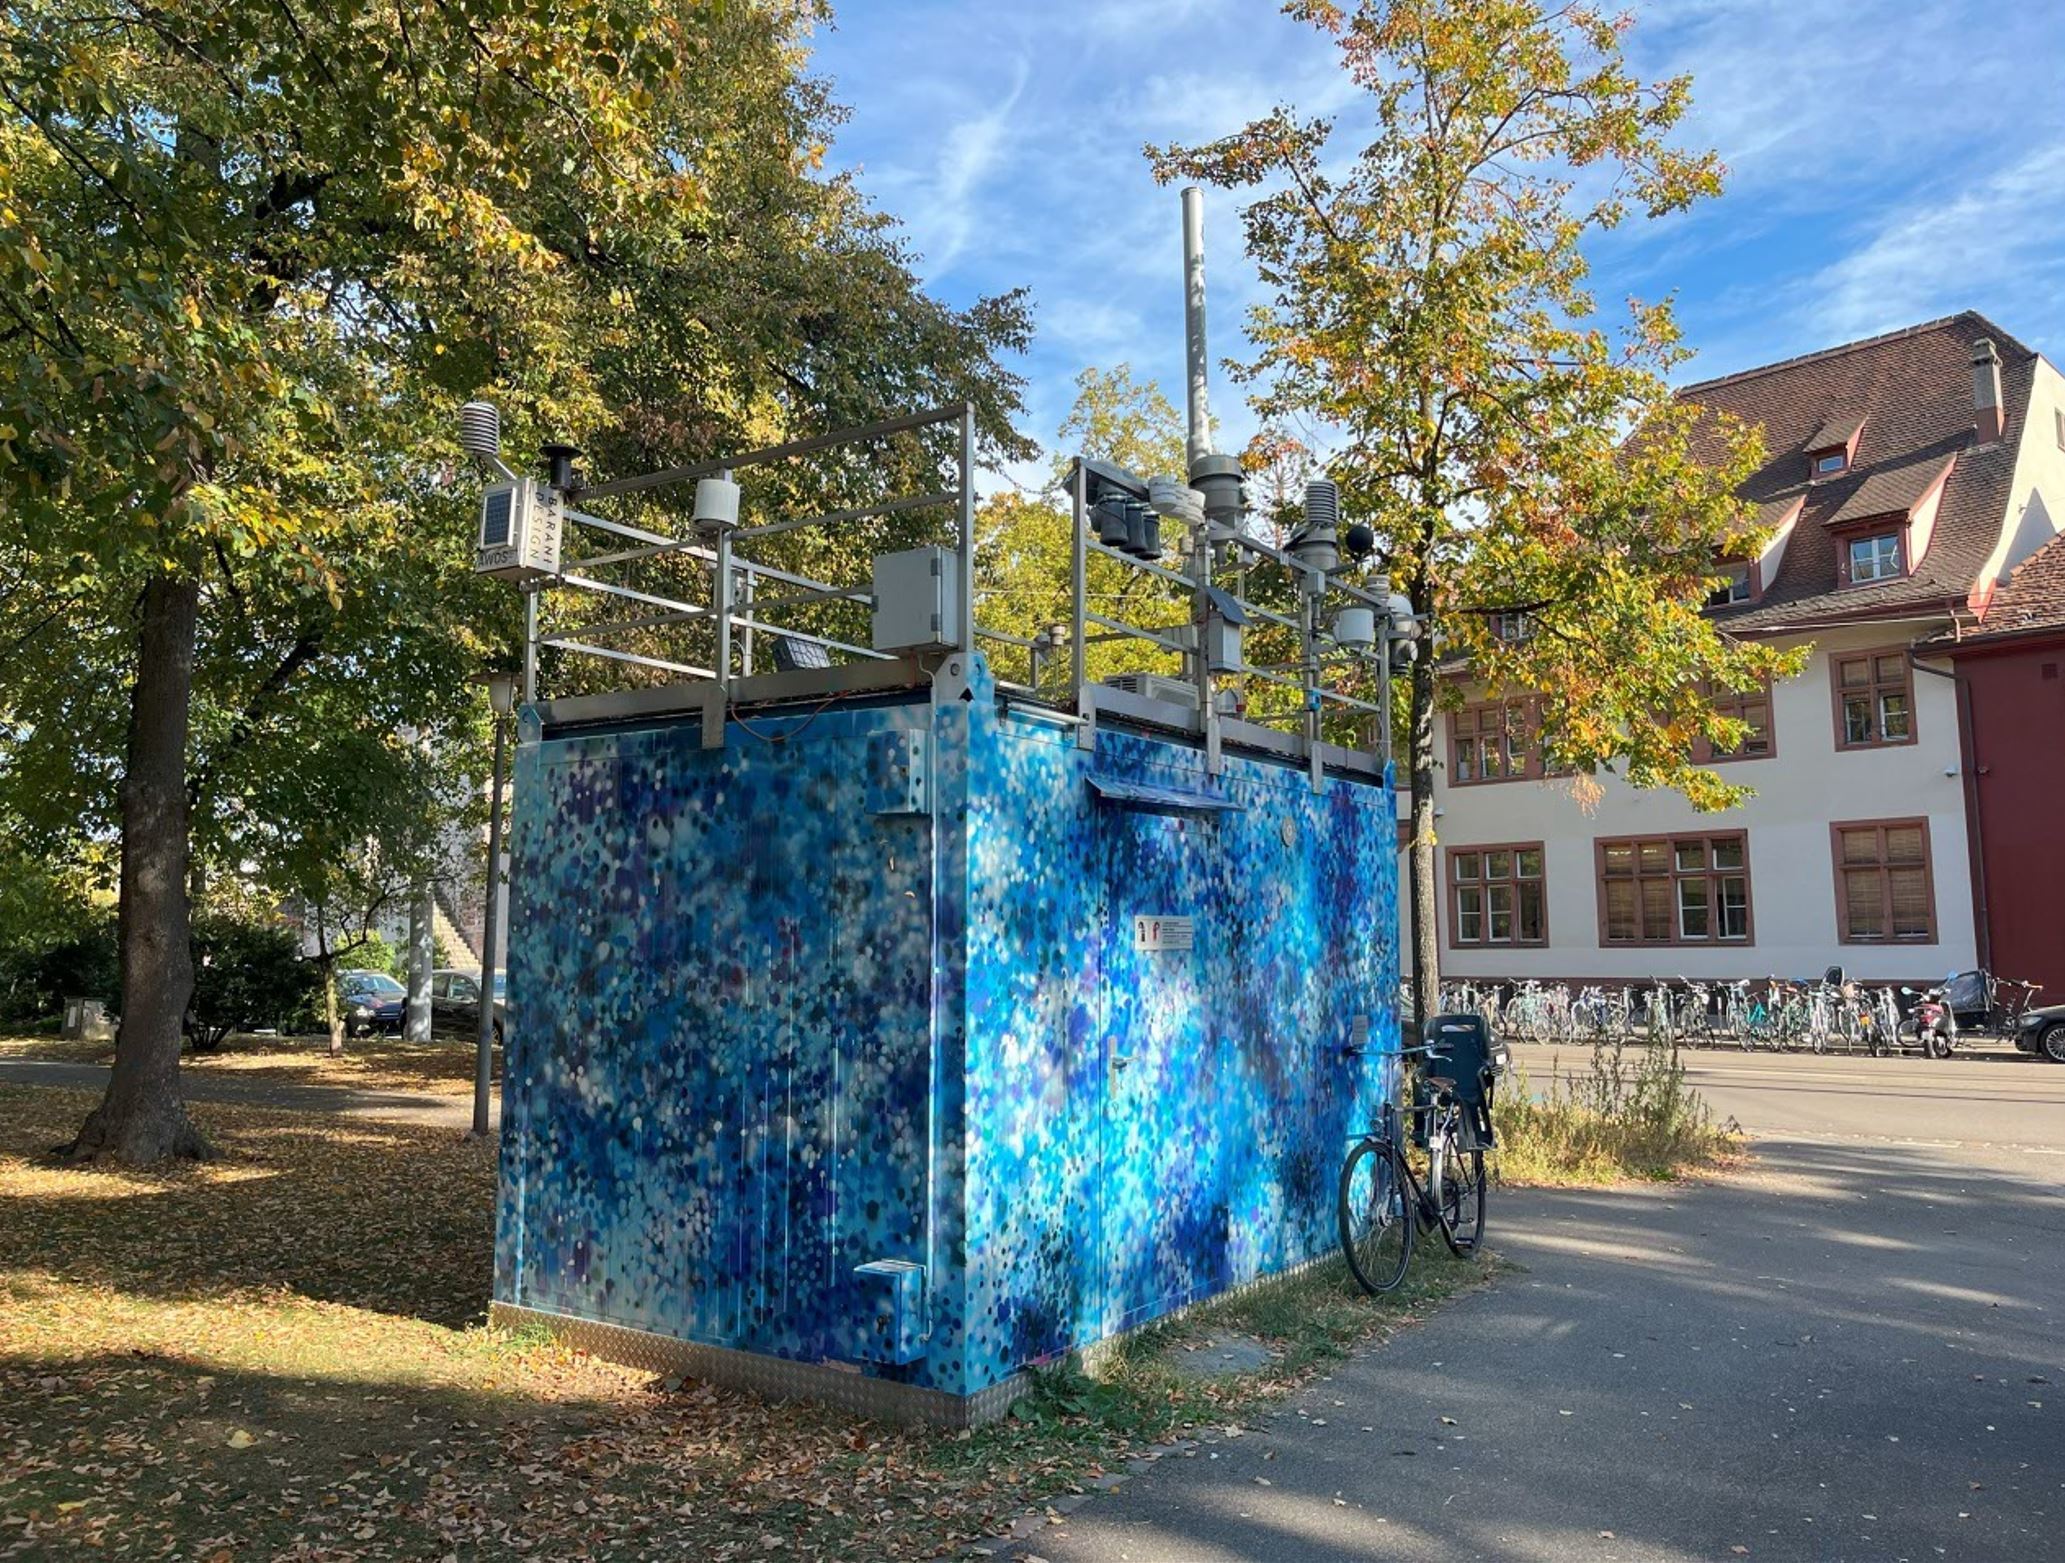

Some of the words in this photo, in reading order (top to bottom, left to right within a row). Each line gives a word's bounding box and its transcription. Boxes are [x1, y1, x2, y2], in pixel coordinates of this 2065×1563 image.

[478, 550, 508, 567] AWOS
[530, 491, 544, 559] DESIGN
[543, 497, 558, 564] BARANI
